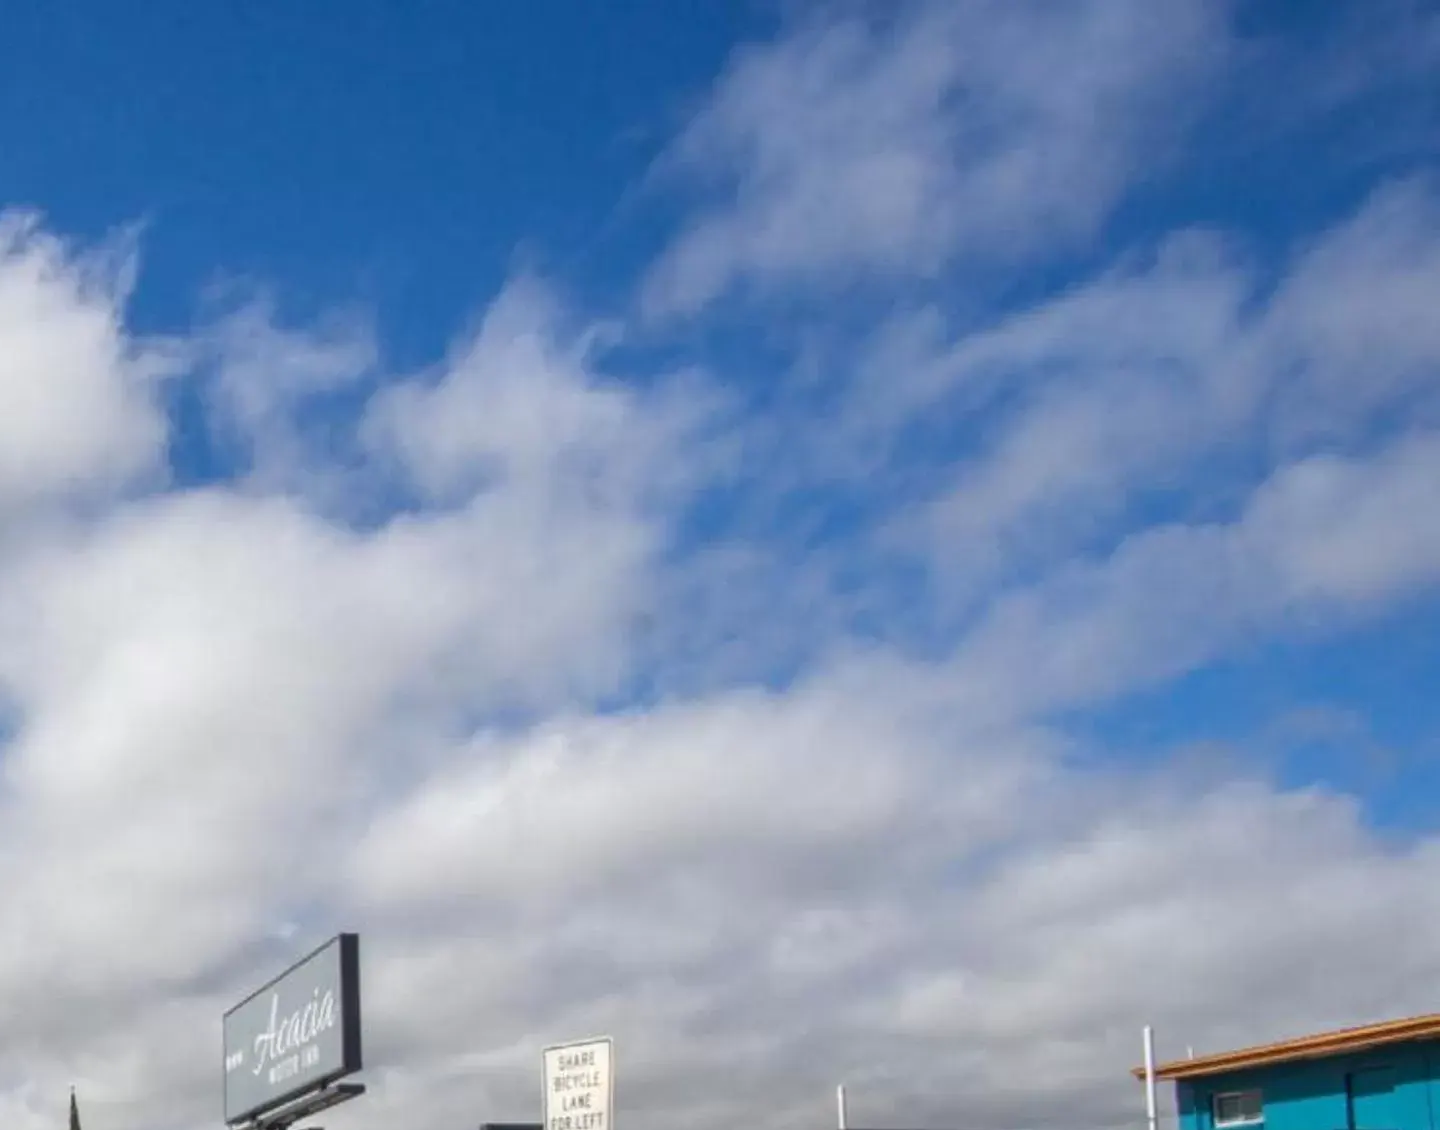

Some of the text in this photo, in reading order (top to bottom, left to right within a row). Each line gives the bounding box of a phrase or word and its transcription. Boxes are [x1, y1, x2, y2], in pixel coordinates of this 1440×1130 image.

[252, 987, 334, 1076] Acacia
[558, 1051, 596, 1071] SHARE
[553, 1071, 601, 1092] BICYCLE
[562, 1092, 592, 1112] LANE
[575, 1112, 604, 1130] LEFT
